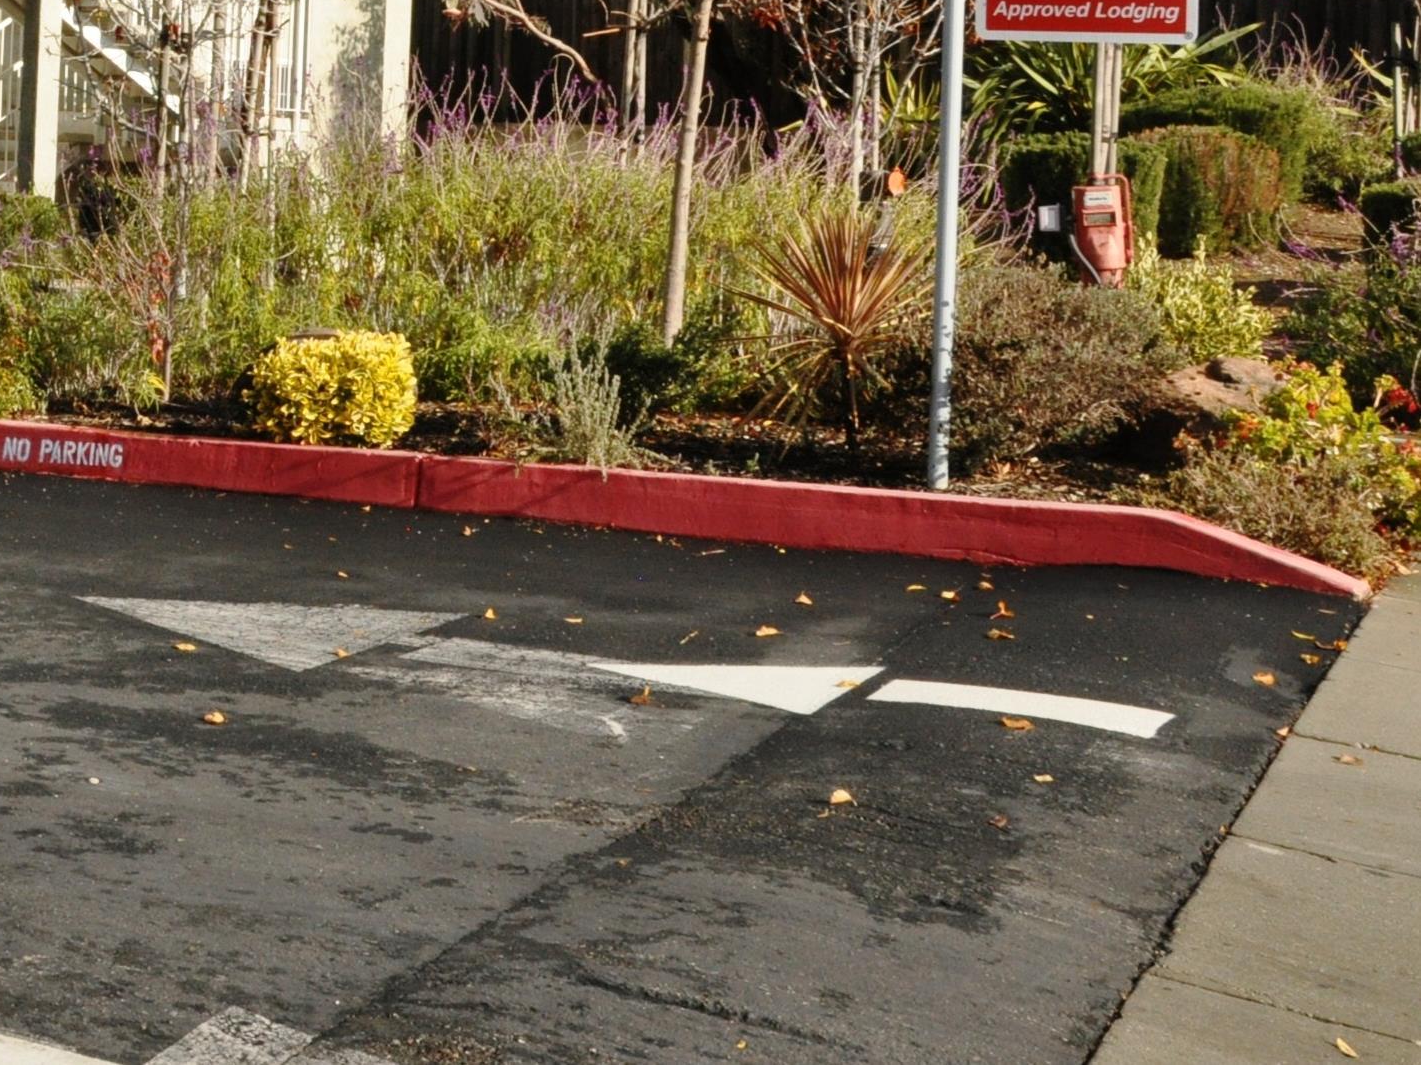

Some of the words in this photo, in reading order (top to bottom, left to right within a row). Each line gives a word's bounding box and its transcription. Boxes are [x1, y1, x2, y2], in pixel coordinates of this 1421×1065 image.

[993, 0, 1091, 22] Approved
[1094, 2, 1180, 24] Lodging
[1, 436, 30, 461] NO
[39, 438, 124, 467] PARKING
